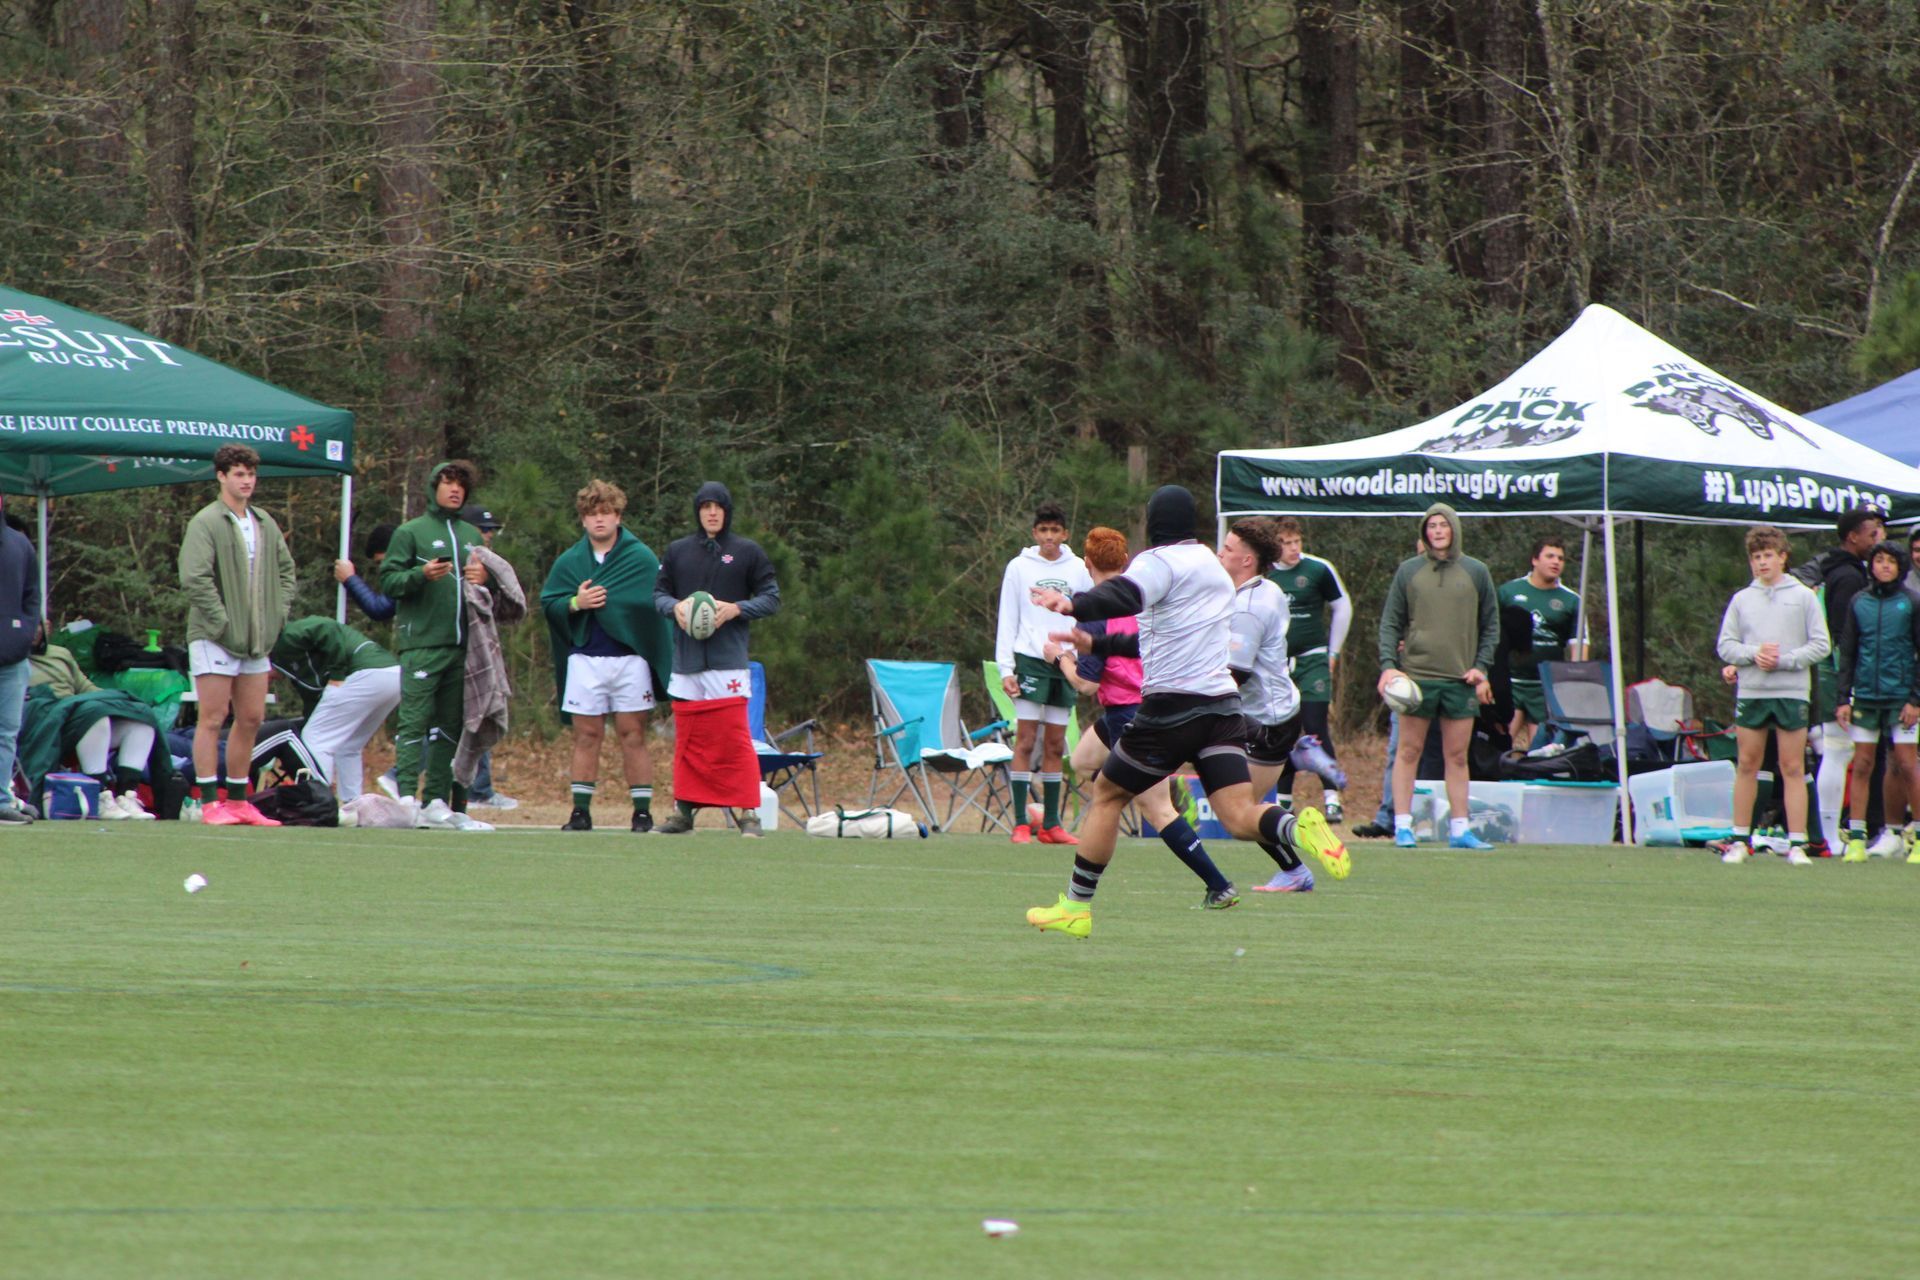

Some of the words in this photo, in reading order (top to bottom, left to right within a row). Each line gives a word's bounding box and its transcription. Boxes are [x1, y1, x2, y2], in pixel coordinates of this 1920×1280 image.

[27, 350, 131, 371] RUGBY
[1518, 386, 1557, 398] THE
[1452, 399, 1597, 428] PACK
[19, 415, 78, 434] JESUIT
[81, 416, 163, 433] COLLEGE
[165, 419, 285, 442] PREPARATORY
[1261, 467, 1560, 500] www.woodlandsrugby.org
